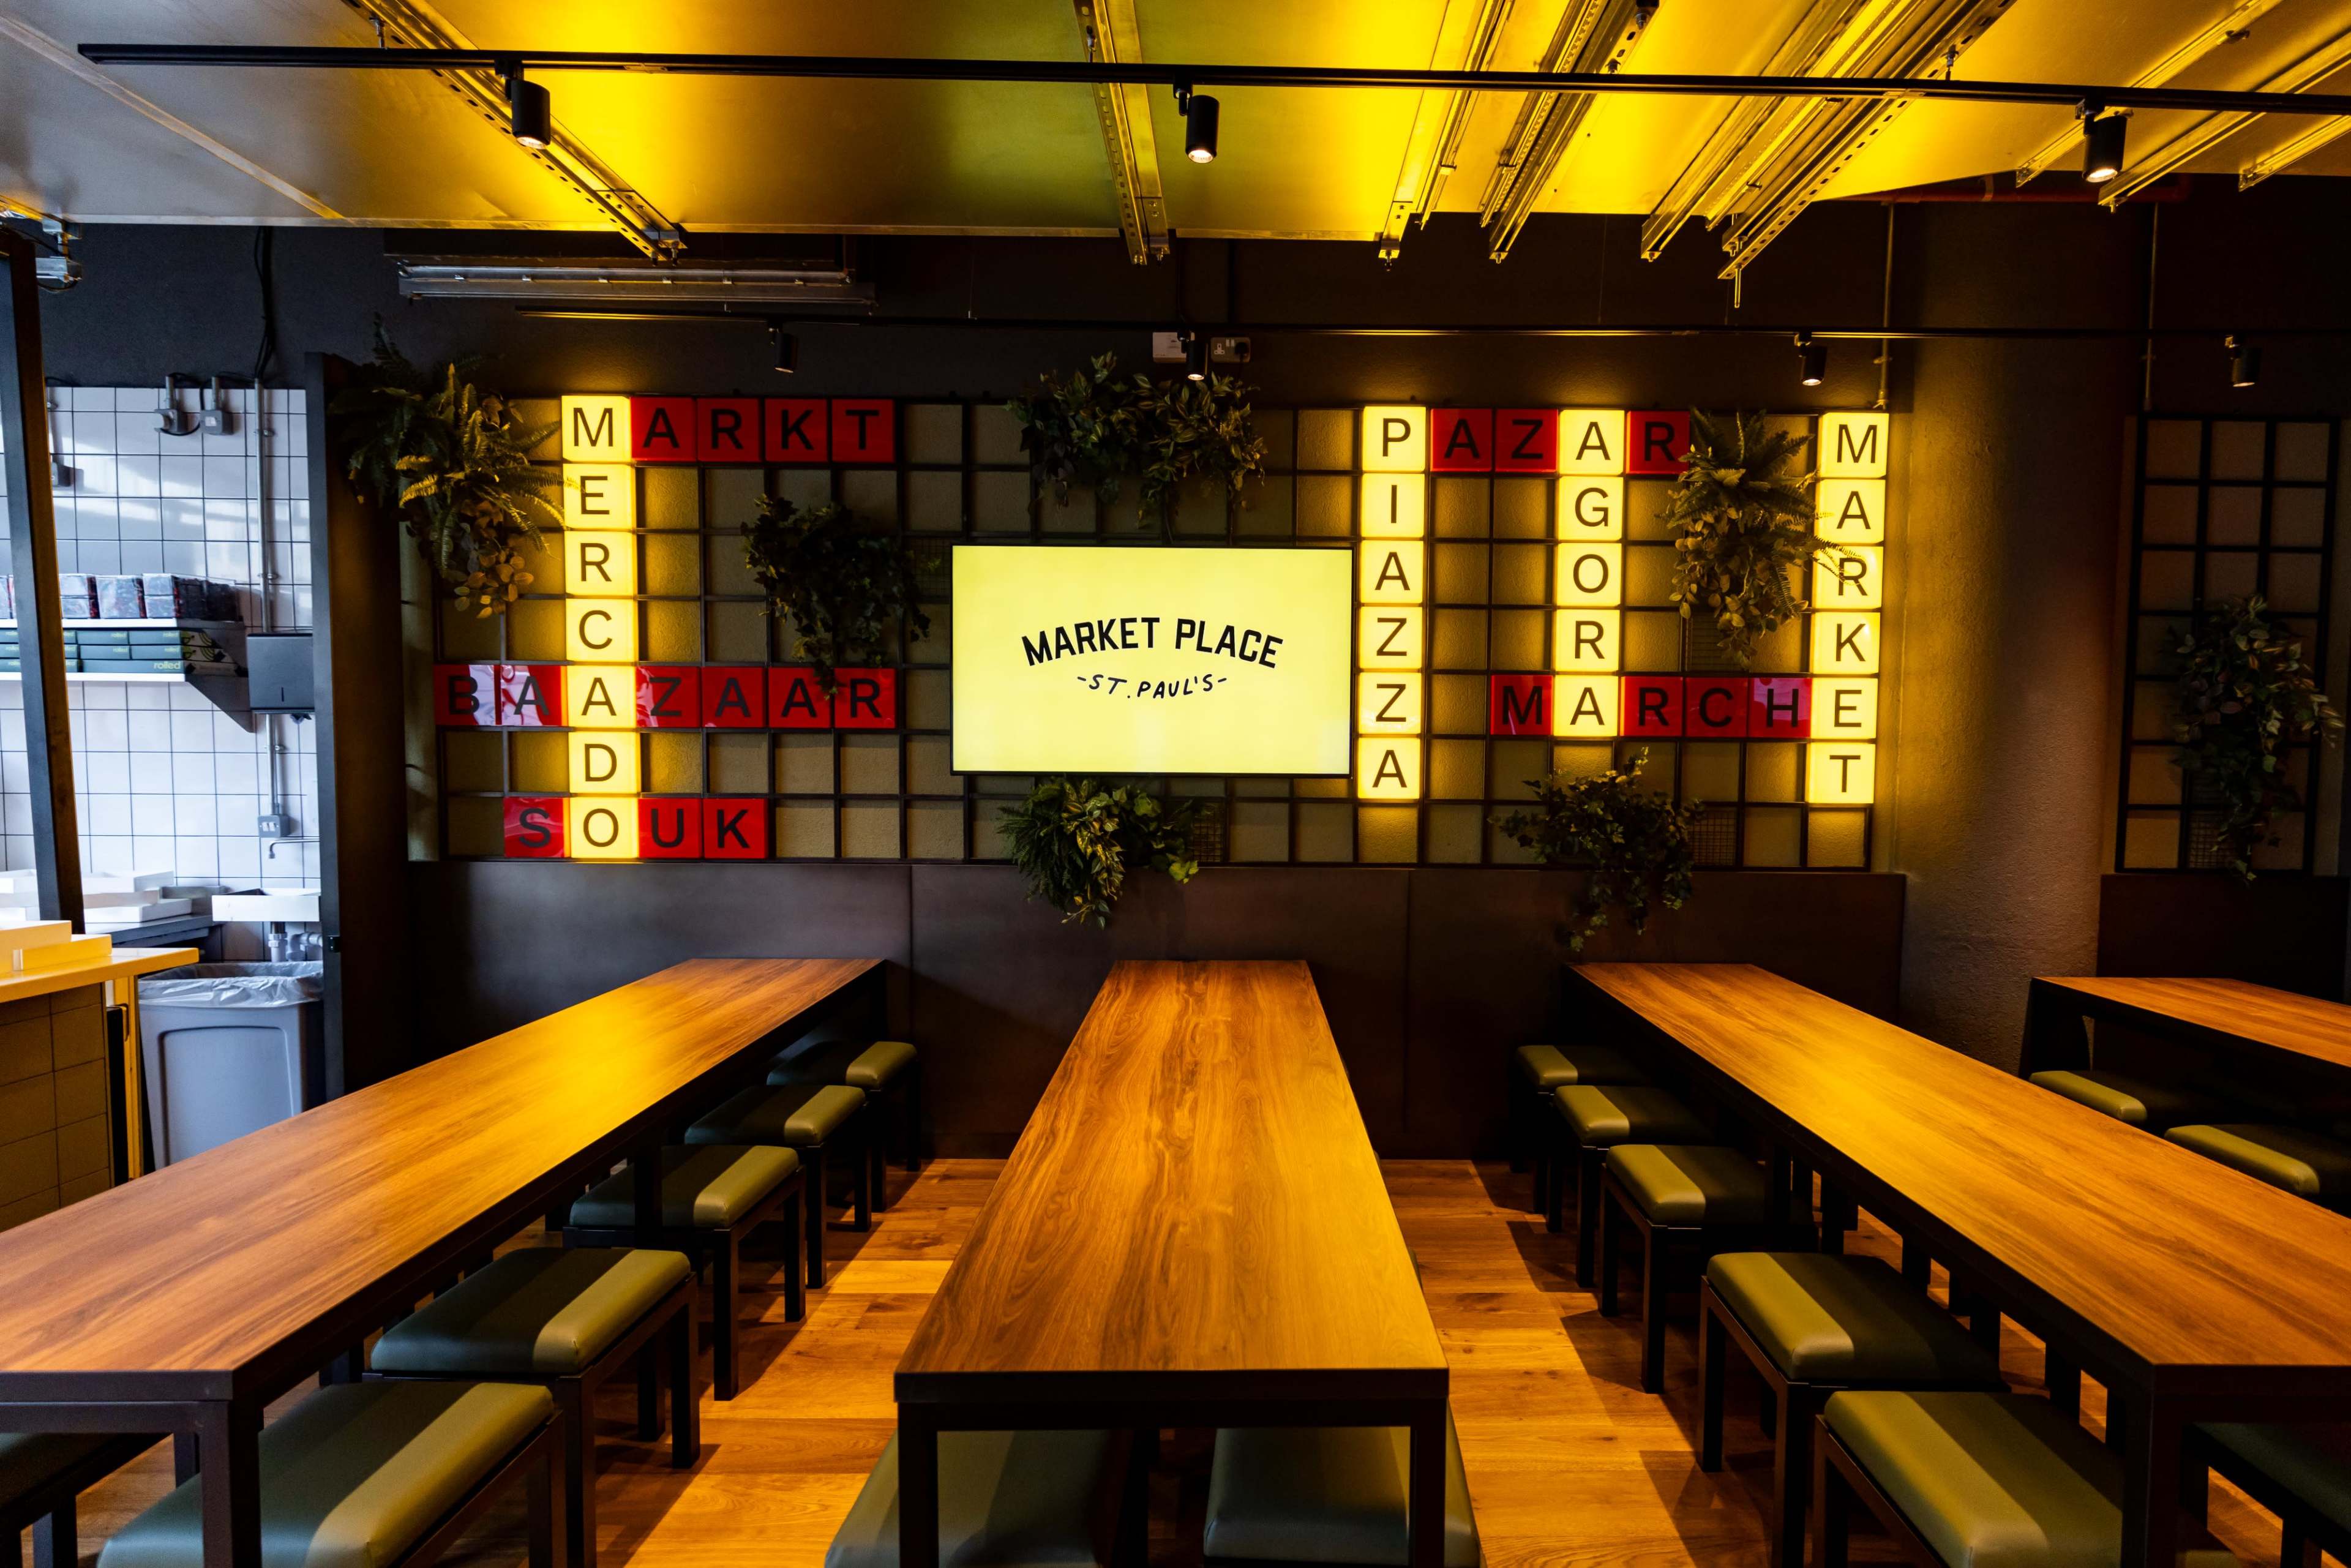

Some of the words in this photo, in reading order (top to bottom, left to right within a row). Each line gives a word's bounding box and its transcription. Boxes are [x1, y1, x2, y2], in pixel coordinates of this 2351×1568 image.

[573, 407, 880, 450] MARKT
[1382, 418, 1676, 461] PAZAR
[1570, 422, 1611, 726] AGORA
[573, 407, 619, 847] MERCADO
[1372, 418, 1411, 789] PIAZZA
[1829, 424, 1878, 793] MARKET
[153, 661, 181, 670] rolled
[1022, 617, 1160, 666] MARKET
[1175, 618, 1283, 669] PLACE
[448, 677, 881, 718] BAAZAAR
[518, 808, 750, 849] SOUK
